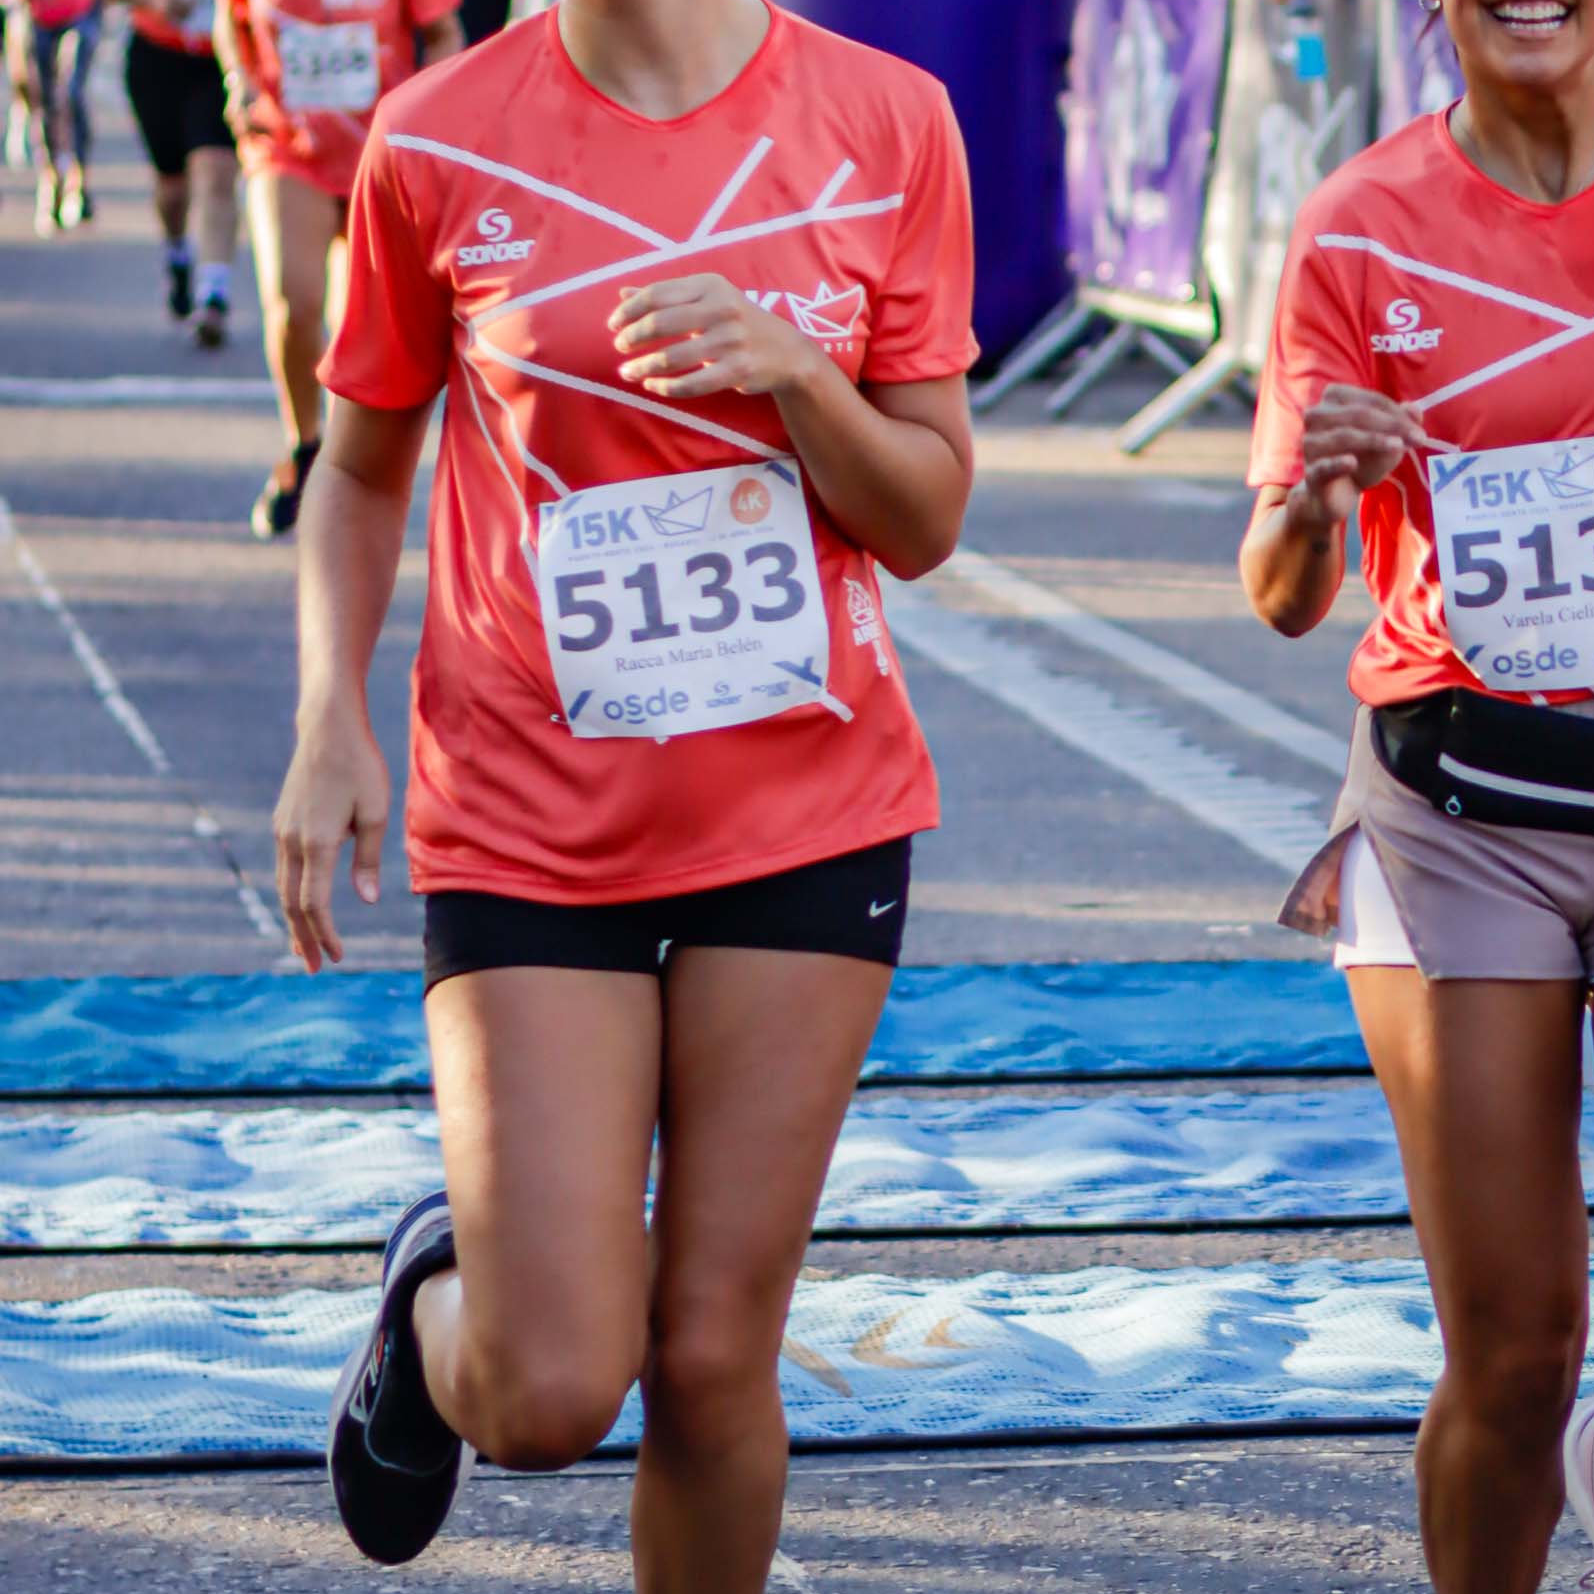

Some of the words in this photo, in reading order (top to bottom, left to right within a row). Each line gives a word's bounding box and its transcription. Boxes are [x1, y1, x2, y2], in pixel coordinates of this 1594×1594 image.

[736, 491, 764, 512] 4K
[1462, 468, 1535, 509] 15K
[565, 506, 639, 550] 15K
[554, 541, 807, 653] 5133
[1502, 610, 1554, 630] Varela
[615, 656, 665, 675] Racca
[1492, 643, 1579, 678] osde
[602, 687, 690, 725] osde
